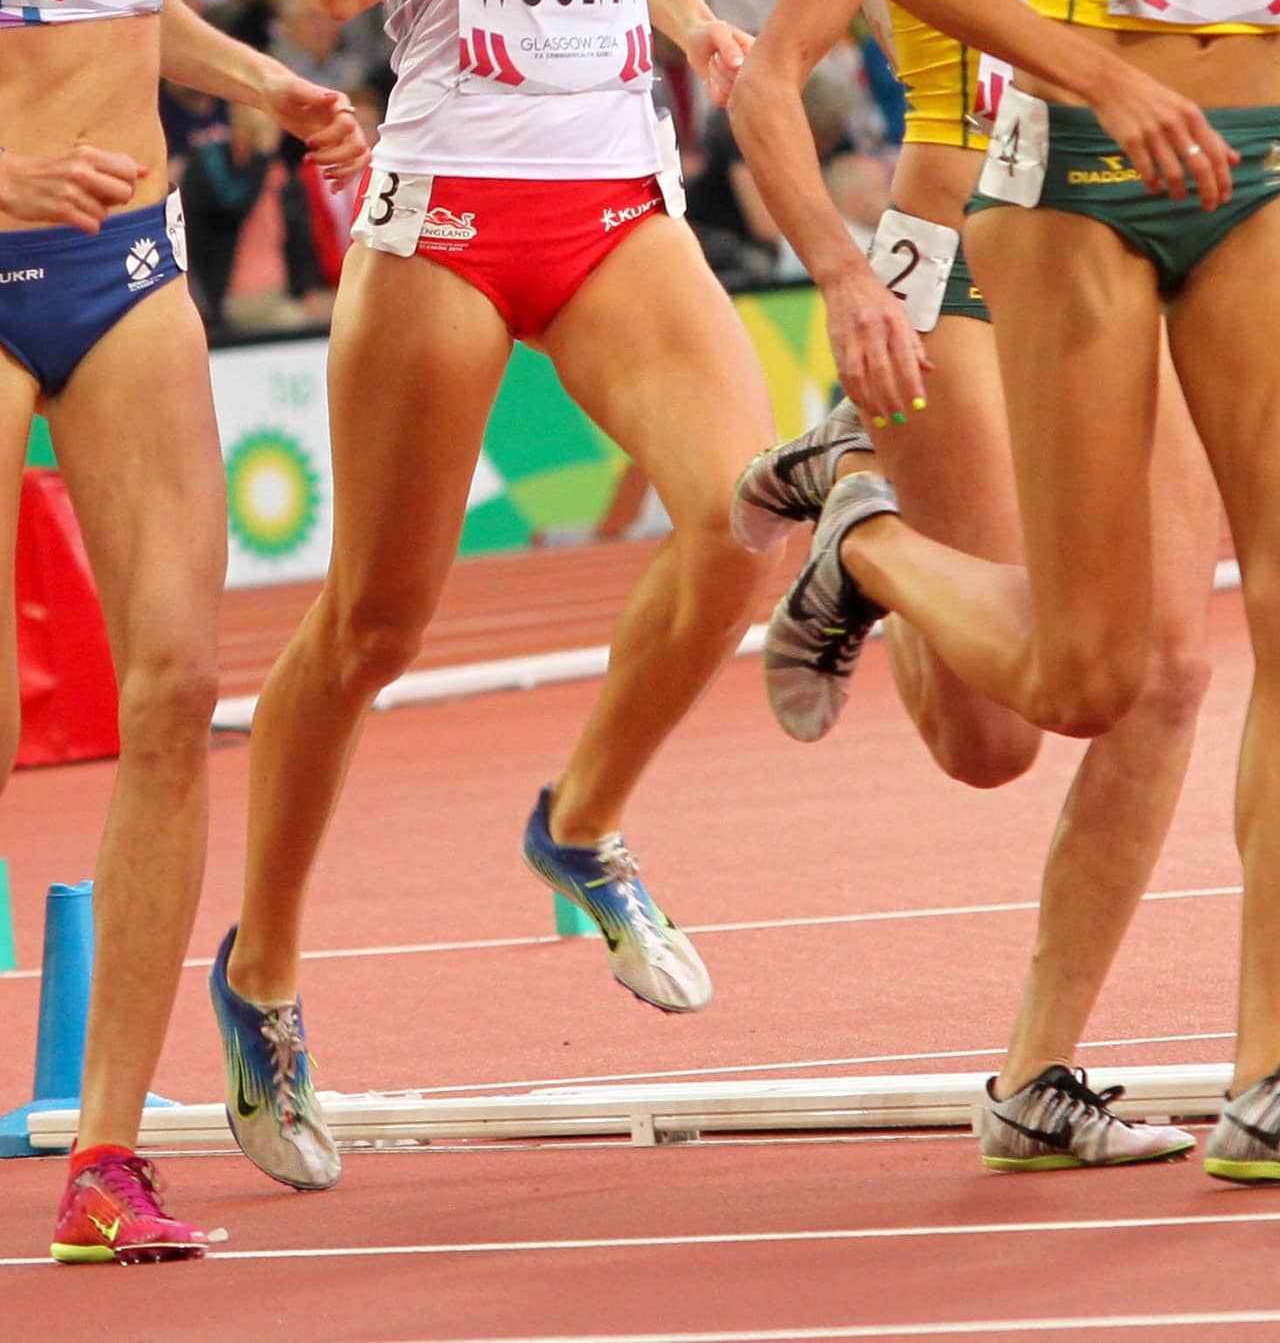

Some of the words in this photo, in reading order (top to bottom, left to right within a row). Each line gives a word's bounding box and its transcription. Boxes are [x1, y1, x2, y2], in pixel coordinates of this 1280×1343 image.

[520, 36, 593, 52] GLASGOW
[997, 121, 1022, 177] 4
[368, 172, 400, 226] 3
[1067, 168, 1142, 185] DIADOR
[884, 238, 920, 301] 2
